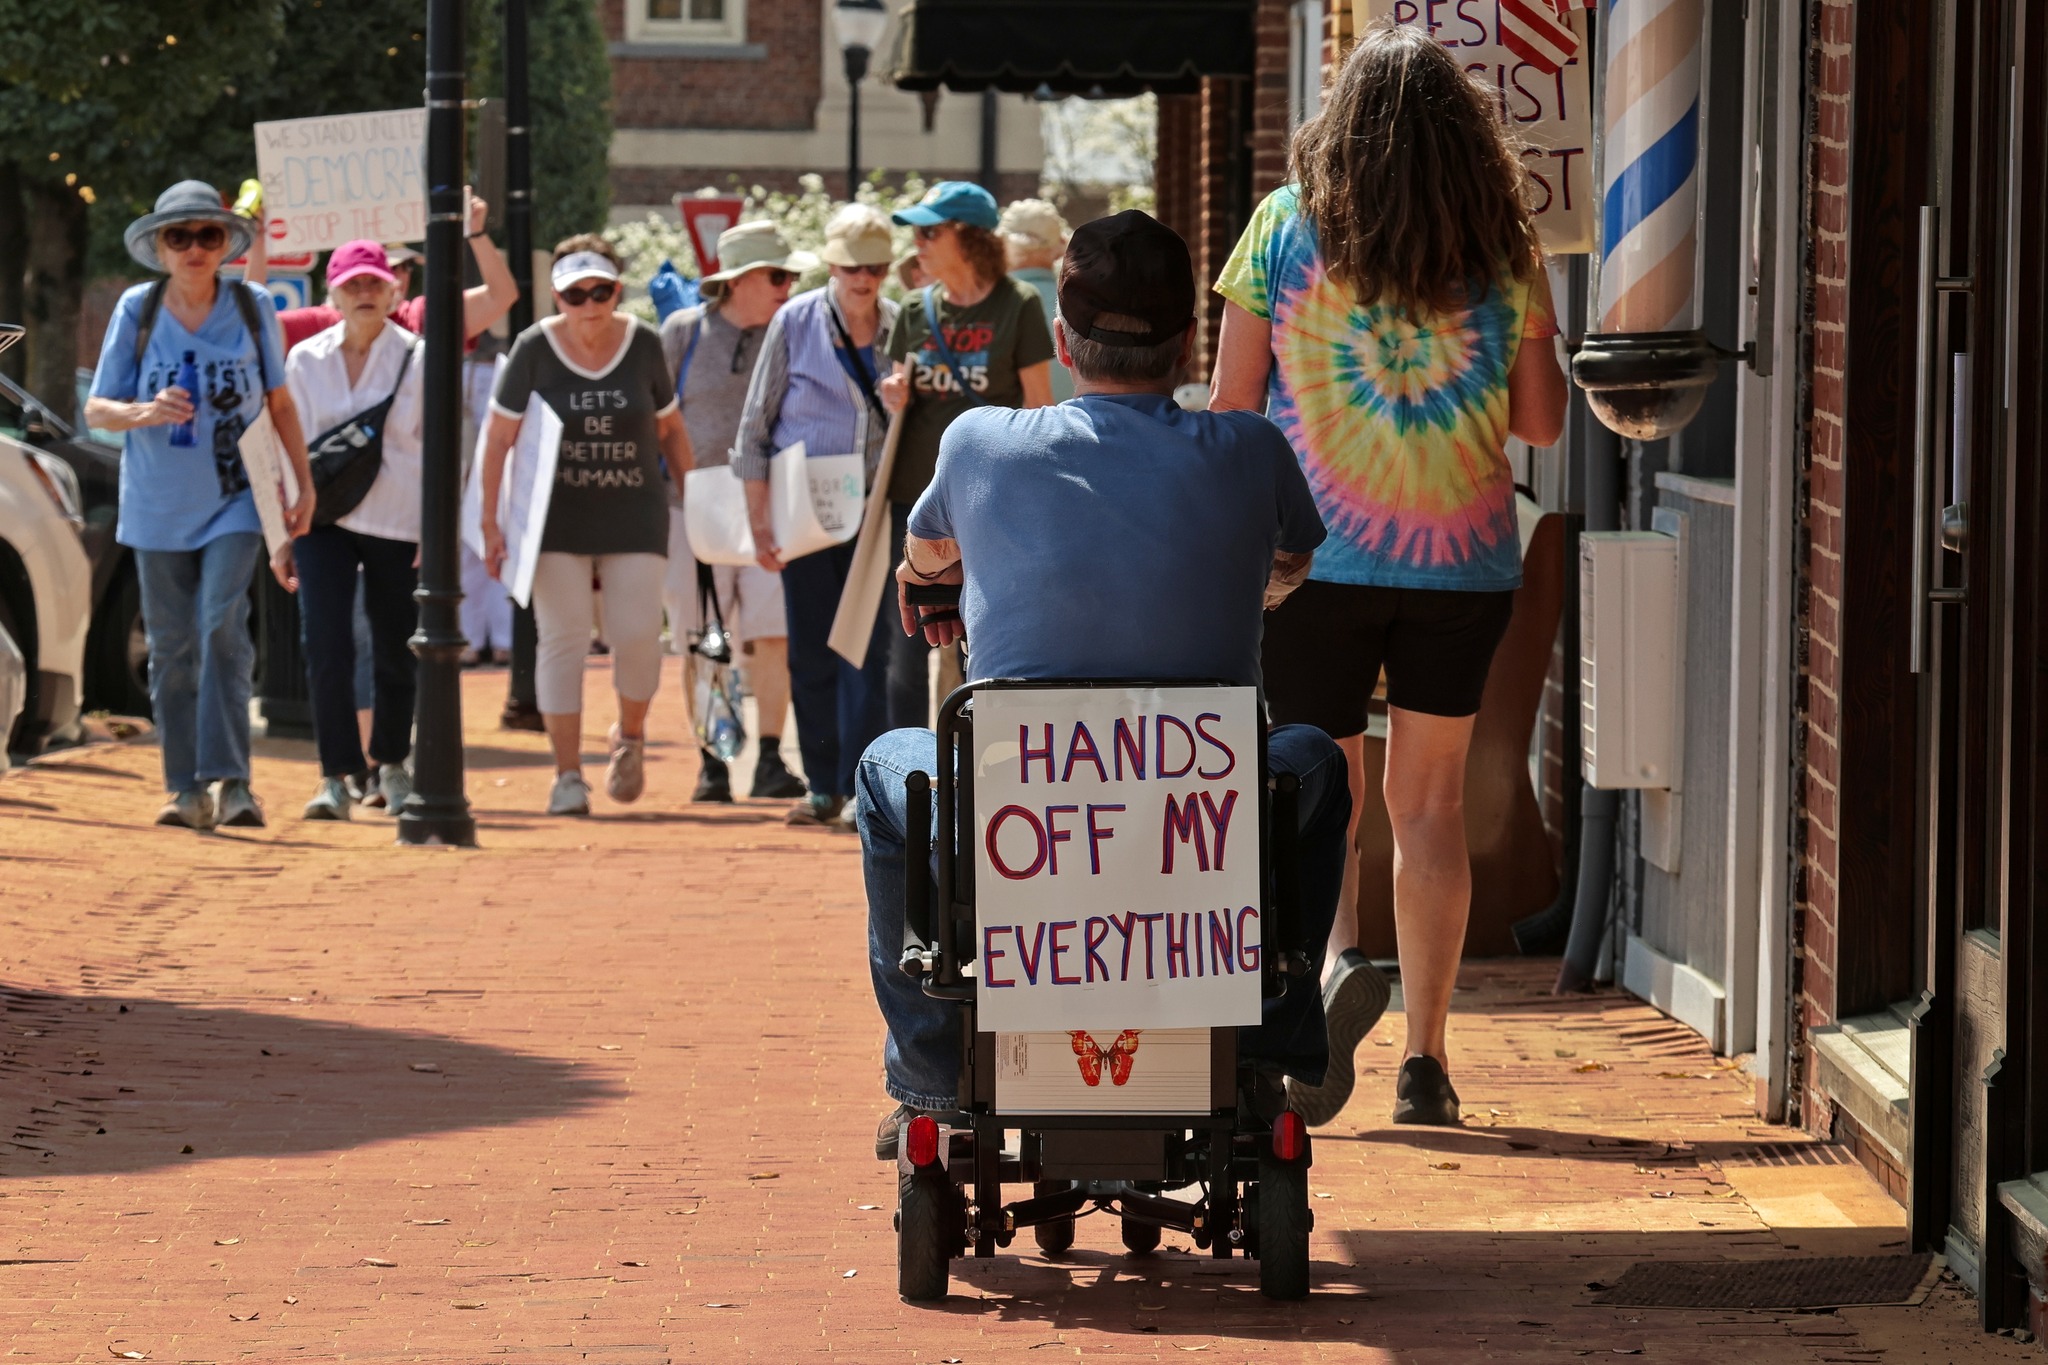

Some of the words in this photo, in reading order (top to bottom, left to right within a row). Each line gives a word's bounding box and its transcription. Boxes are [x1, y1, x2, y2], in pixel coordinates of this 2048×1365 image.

[262, 126, 293, 149] WE
[298, 119, 357, 148] STAND
[361, 112, 425, 143] UNITE
[290, 211, 341, 246] STOP
[350, 205, 386, 240] THE
[395, 201, 427, 235] ST
[569, 389, 628, 410] LET'S
[584, 415, 614, 435] BE
[562, 440, 637, 462] BETTER
[556, 466, 644, 488] HUMANS
[1018, 712, 1237, 784] HANDS
[985, 803, 1127, 881] OFF
[1160, 789, 1239, 875] MY
[983, 905, 1262, 989] EVERYTHING
